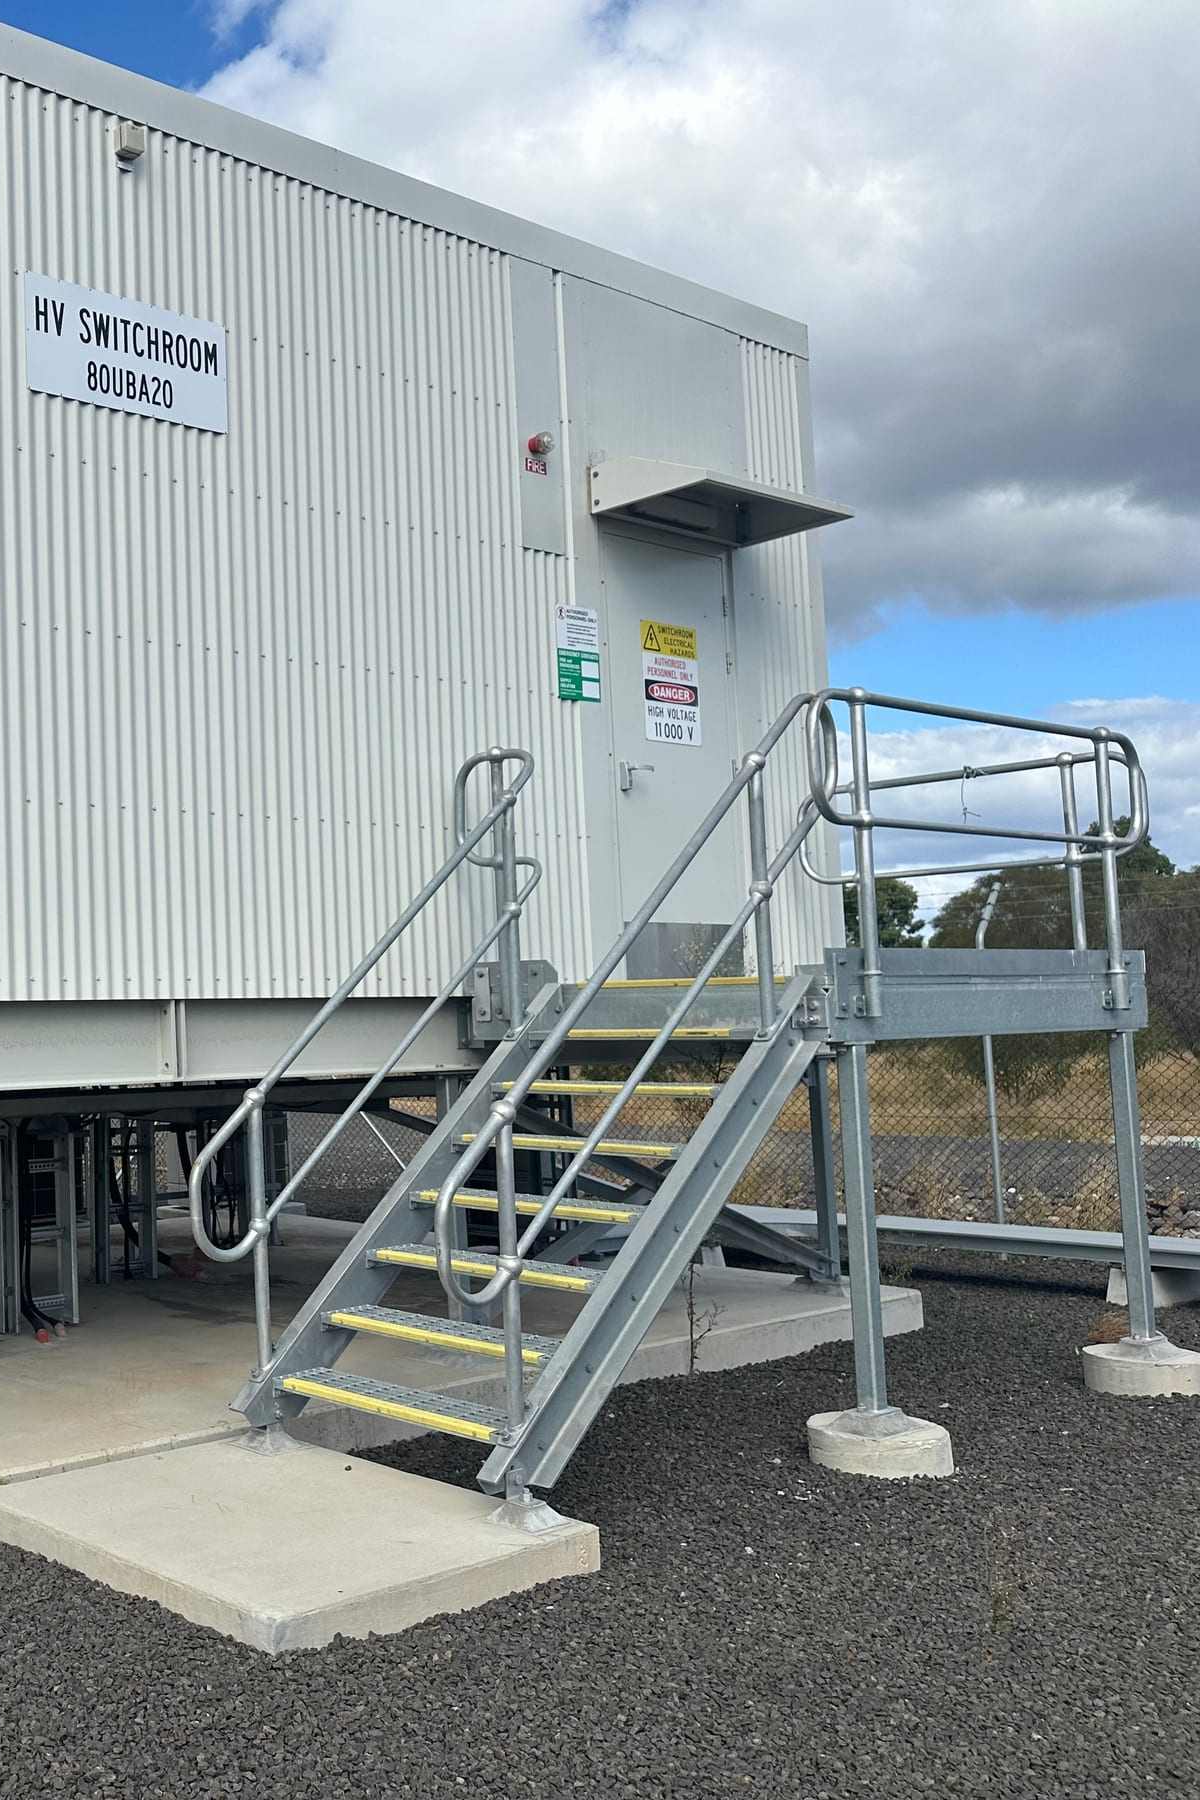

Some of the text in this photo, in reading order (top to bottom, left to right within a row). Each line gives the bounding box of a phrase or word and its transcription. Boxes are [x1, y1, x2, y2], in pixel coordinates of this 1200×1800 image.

[34, 295, 218, 377] HV SWITCHROOM
[87, 360, 173, 409] 80UBA20
[528, 459, 545, 474] FIRE
[658, 625, 693, 639] SWITCHROOM
[664, 637, 694, 649] ELECTRICAL
[679, 672, 693, 682] ONLY
[653, 686, 690, 701] DANGER
[648, 705, 696, 722] HIGH VOLTAGE
[687, 726, 694, 741] V
